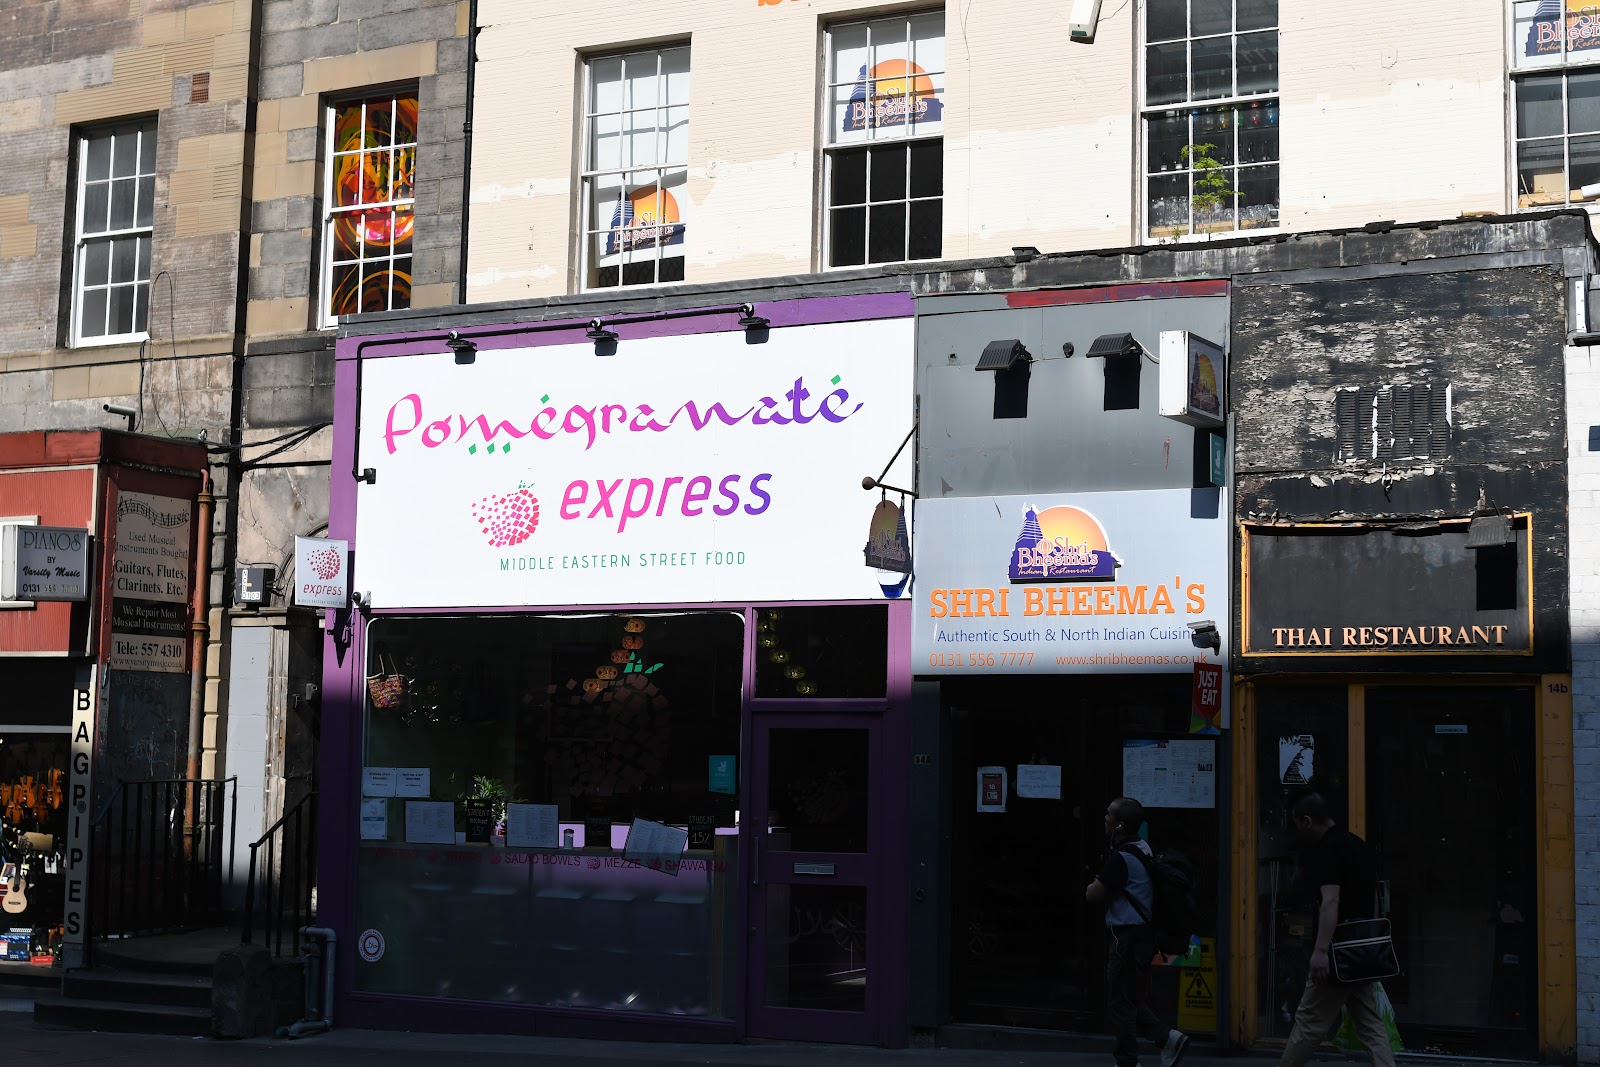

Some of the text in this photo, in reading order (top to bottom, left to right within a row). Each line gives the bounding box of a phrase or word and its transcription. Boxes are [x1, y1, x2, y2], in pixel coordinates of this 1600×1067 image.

[559, 472, 772, 534] express
[124, 499, 190, 527] Varsity Music
[23, 531, 82, 551] PIANOS
[129, 531, 176, 546] Used Musical
[1052, 536, 1089, 556] Shri
[115, 541, 188, 560] Instruments Bought!
[1017, 548, 1099, 567] Bheema's
[47, 555, 57, 564] BY
[500, 550, 746, 571] MIDDLE EASTERN STREET FOOD
[22, 565, 80, 579] Varsity Music
[115, 559, 187, 581] Guitars, Flutes,
[1017, 565, 1097, 576] Indian Restaurant
[22, 583, 40, 593] 0131
[166, 582, 184, 596] Etc.
[303, 583, 342, 597] express
[930, 575, 1206, 618] SHRI BHEEMA'S
[122, 605, 177, 619] We Repair Most
[112, 616, 186, 632] Musical Instruments!
[937, 629, 1000, 643] Authentic
[1002, 628, 1040, 643] South
[1044, 628, 1056, 642] &
[1061, 627, 1099, 642] North
[1103, 627, 1146, 642] Indian
[1271, 625, 1508, 647] THAI RESTAURANT
[115, 641, 182, 658] Tele: 557 4310
[929, 652, 1035, 668] 0131 556 7777
[1055, 651, 1208, 666] www.shribheemas.co.uk
[1198, 670, 1219, 689] JUST
[1548, 683, 1568, 694] 14b
[1201, 688, 1218, 706] EAT
[67, 688, 91, 935] BAGPIPES
[504, 853, 581, 867] SALAD BOWLS
[604, 858, 642, 869] MEZZE
